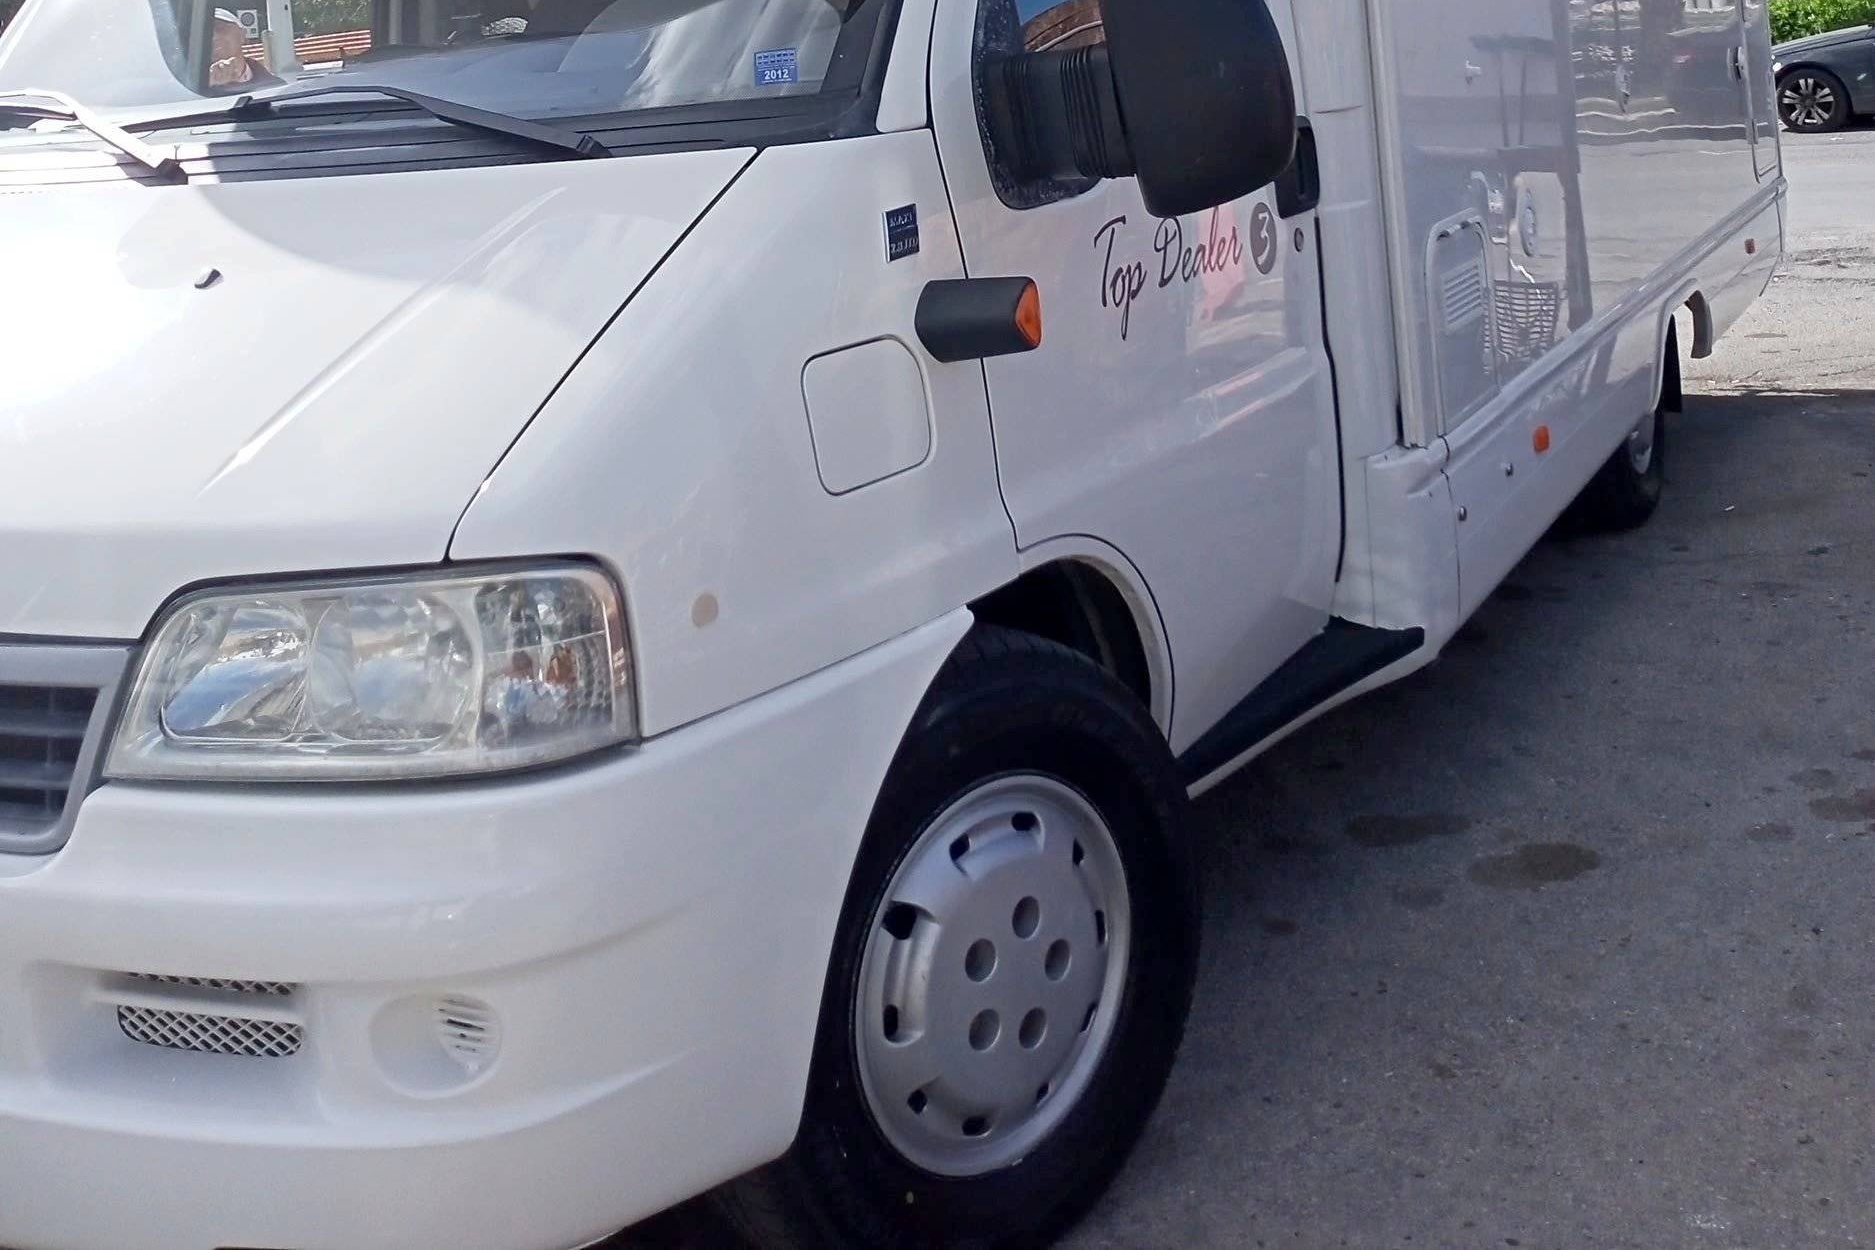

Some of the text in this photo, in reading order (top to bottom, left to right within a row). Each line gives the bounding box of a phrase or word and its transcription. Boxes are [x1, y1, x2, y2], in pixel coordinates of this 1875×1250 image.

[764, 69, 789, 80] 2012
[1094, 215, 1148, 341] Top
[1153, 206, 1243, 288] Dealer
